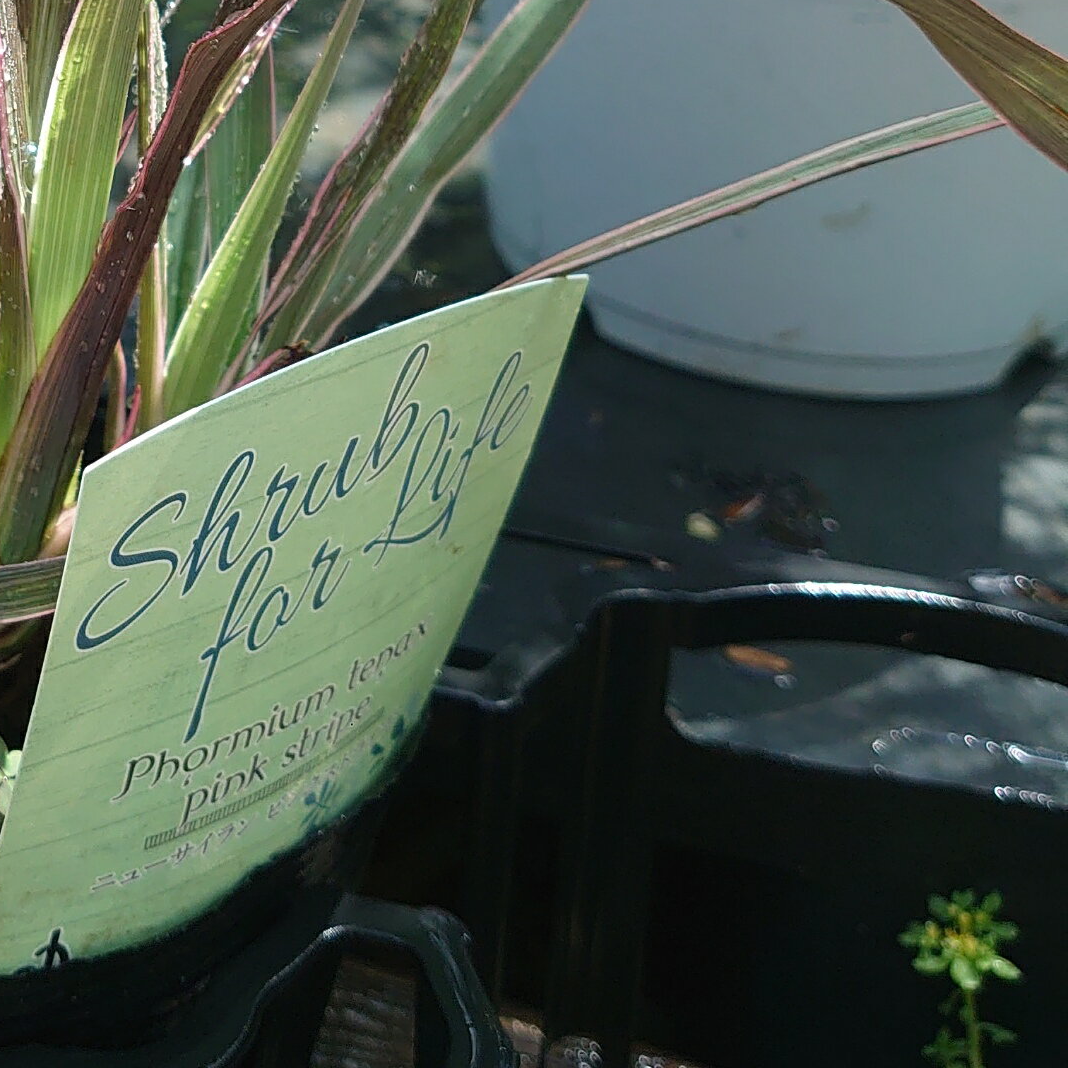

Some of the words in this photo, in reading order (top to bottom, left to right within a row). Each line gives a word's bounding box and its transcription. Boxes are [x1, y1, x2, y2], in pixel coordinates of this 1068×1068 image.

[76, 343, 428, 650] Shrub
[184, 538, 350, 744] for
[363, 351, 532, 567] Life
[112, 685, 334, 802] Phormium
